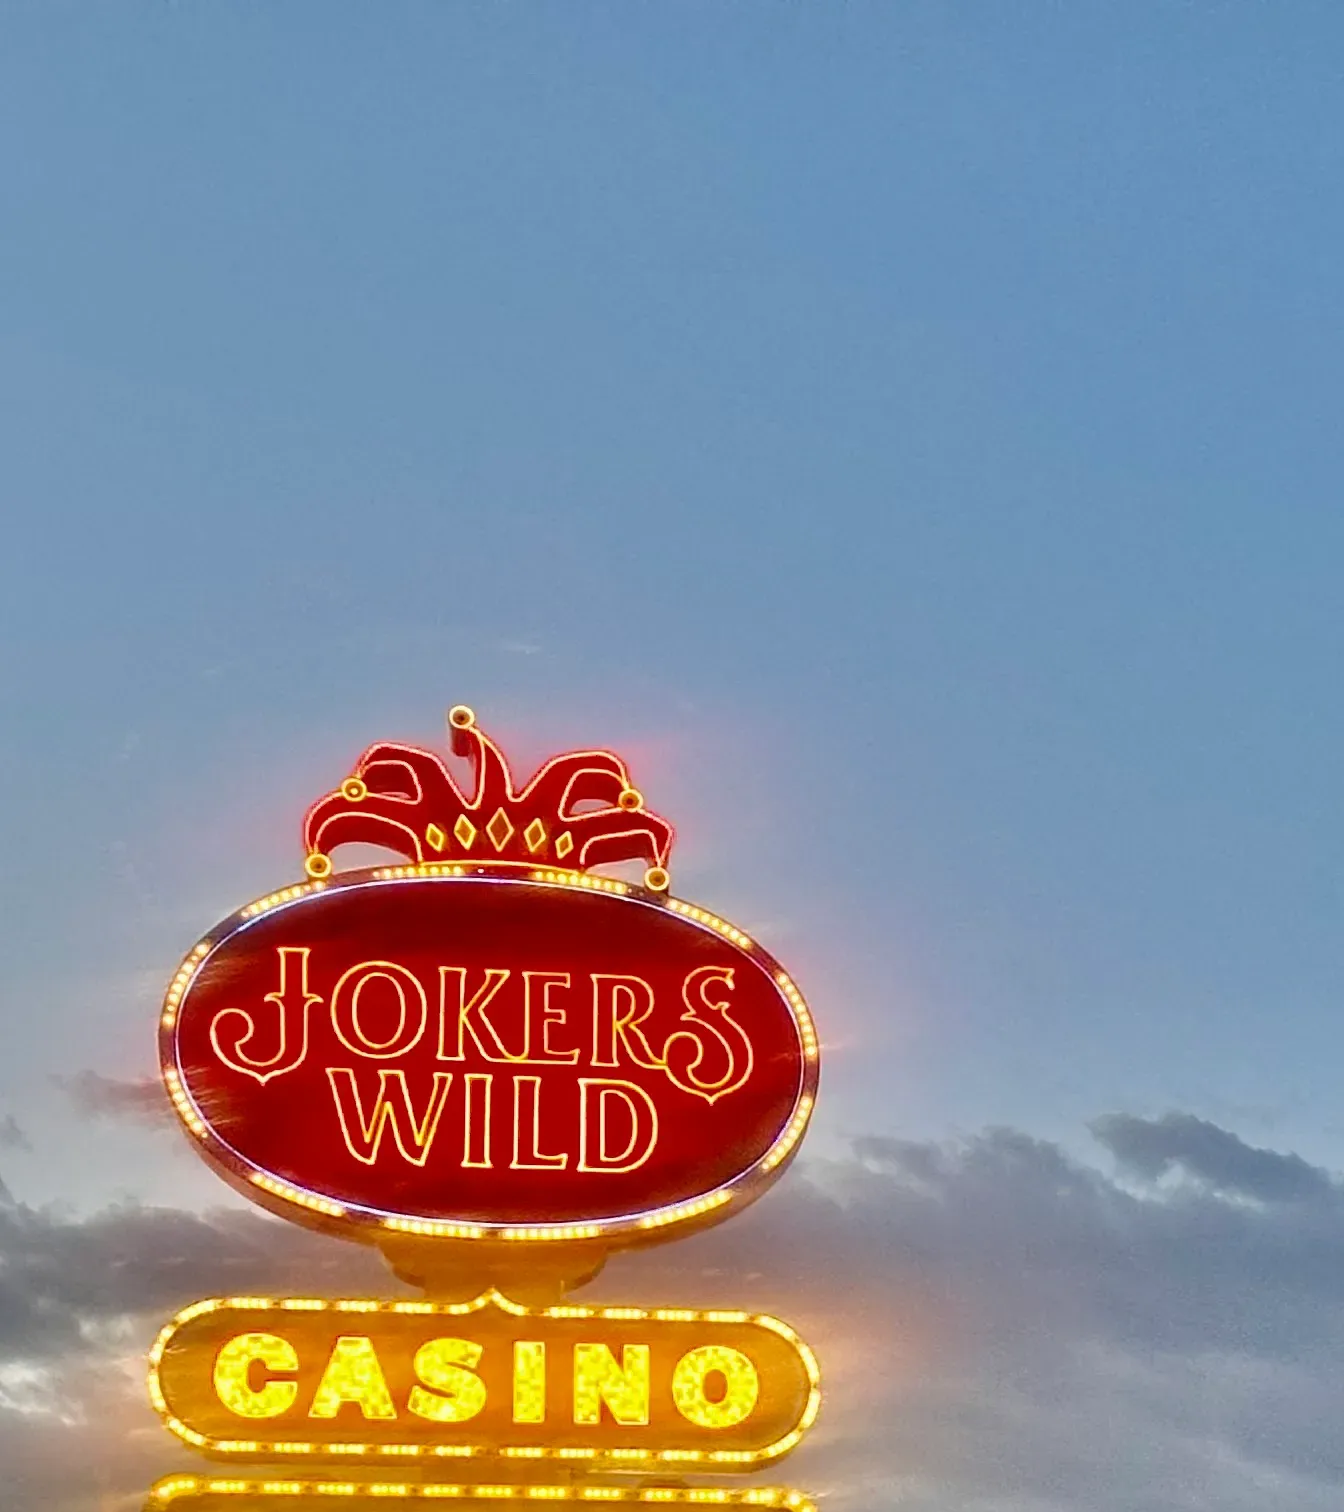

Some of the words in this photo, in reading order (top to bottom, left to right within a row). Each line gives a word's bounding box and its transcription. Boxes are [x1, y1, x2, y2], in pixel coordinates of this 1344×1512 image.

[209, 946, 755, 1105] JOKERS
[326, 1066, 659, 1173] WILD
[212, 1332, 760, 1429] CASINO
